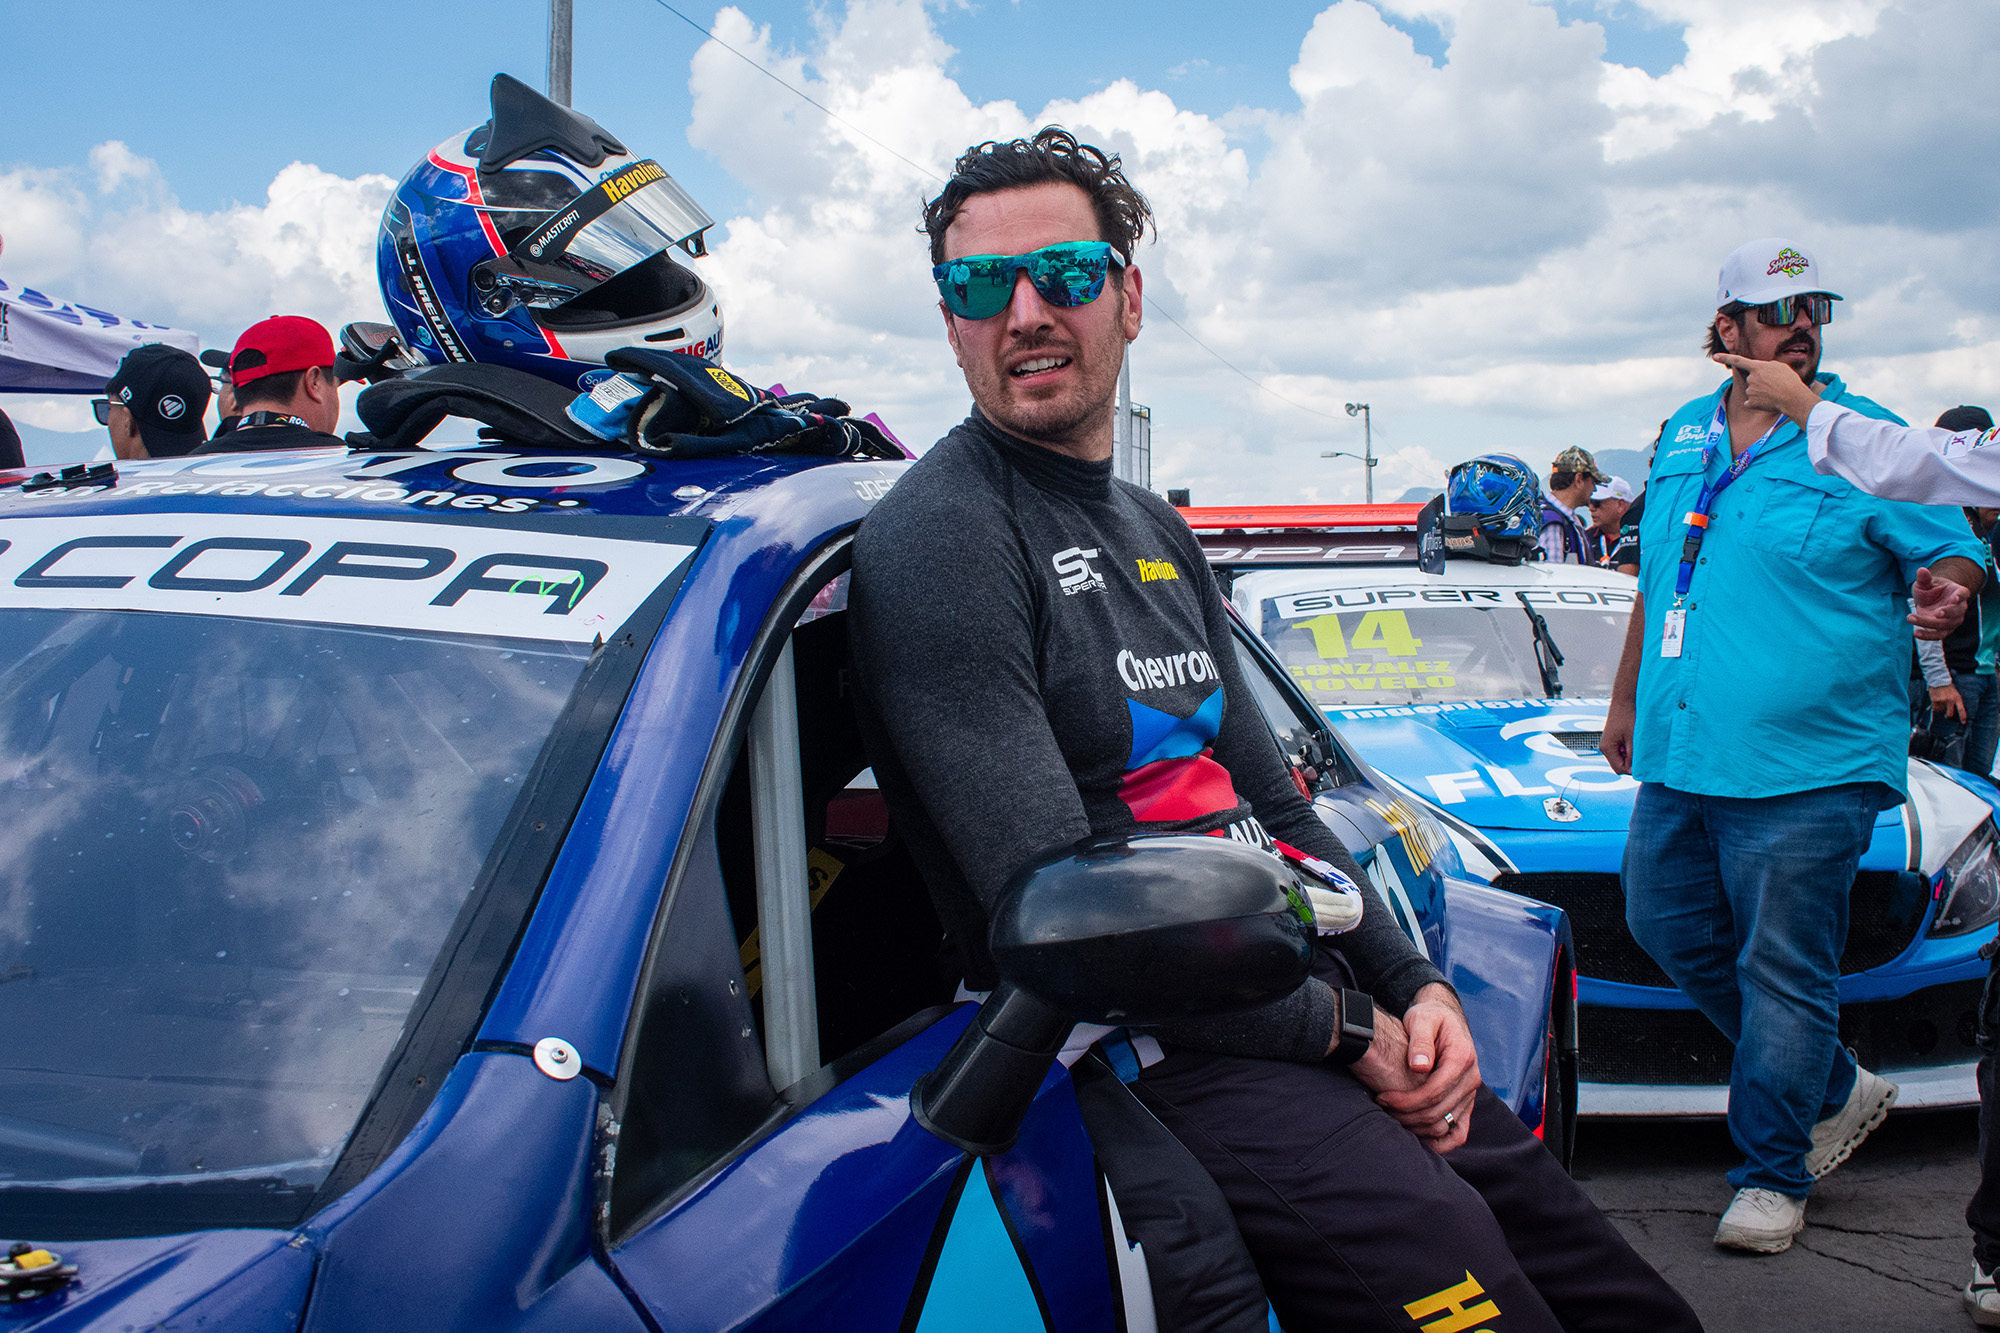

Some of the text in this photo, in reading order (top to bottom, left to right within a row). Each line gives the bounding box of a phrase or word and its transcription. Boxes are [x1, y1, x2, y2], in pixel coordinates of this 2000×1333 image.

[600, 162, 667, 204] Havoline
[1201, 546, 1406, 561] OPA
[14, 535, 609, 615] COPA
[1292, 590, 1636, 612] SUPER COP
[1292, 610, 1423, 659] 14
[1116, 649, 1219, 691] Chevron
